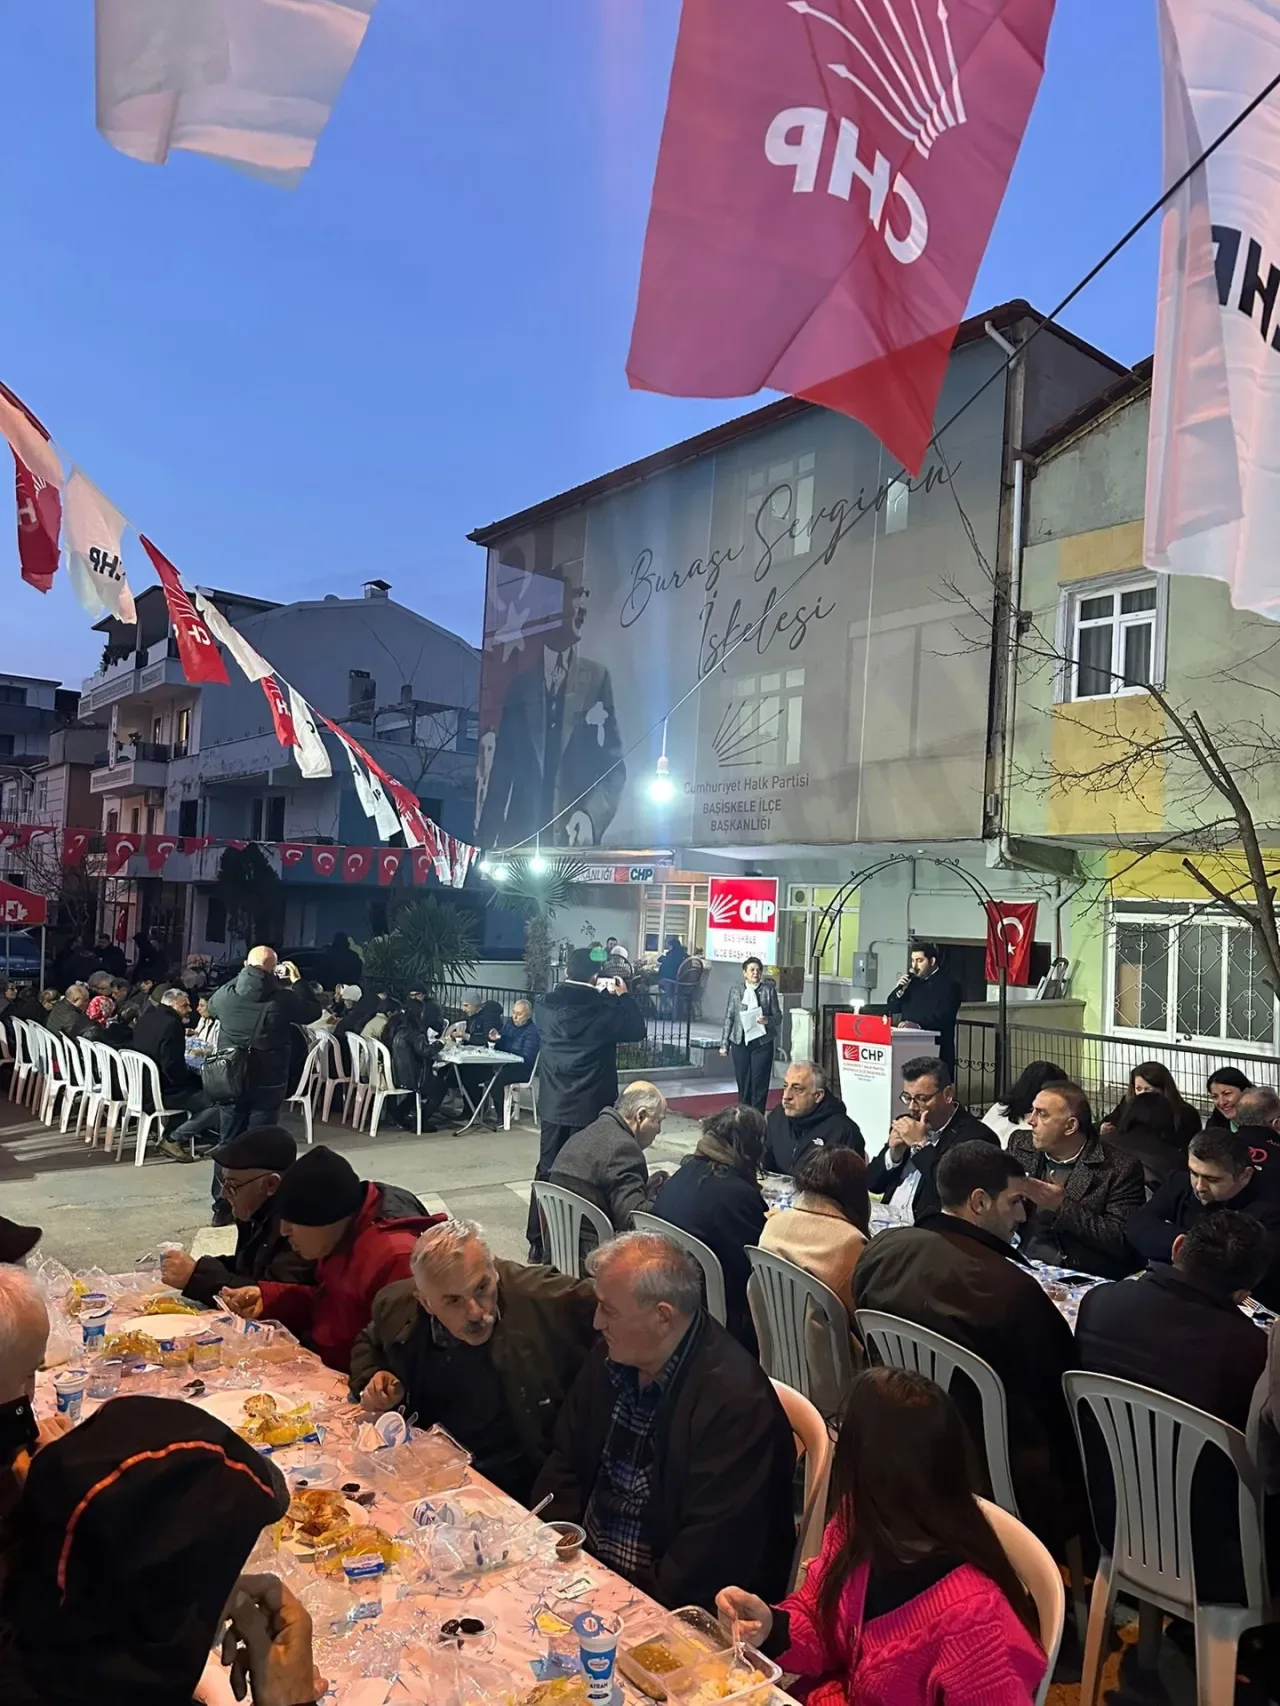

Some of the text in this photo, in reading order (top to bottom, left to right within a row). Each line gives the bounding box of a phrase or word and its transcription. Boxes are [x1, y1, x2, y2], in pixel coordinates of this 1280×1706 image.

[620, 544, 745, 628] Burası
[697, 587, 837, 680] İskelesi
[684, 773, 809, 795] Cumhuriyet Halk Partisi
[703, 797, 782, 816] BAŞİSKELE İLÇE
[711, 816, 771, 834] BAŞKANLIĞI
[630, 868, 653, 881] CHP
[739, 898, 775, 923] CHP
[861, 1048, 884, 1061] CHP
